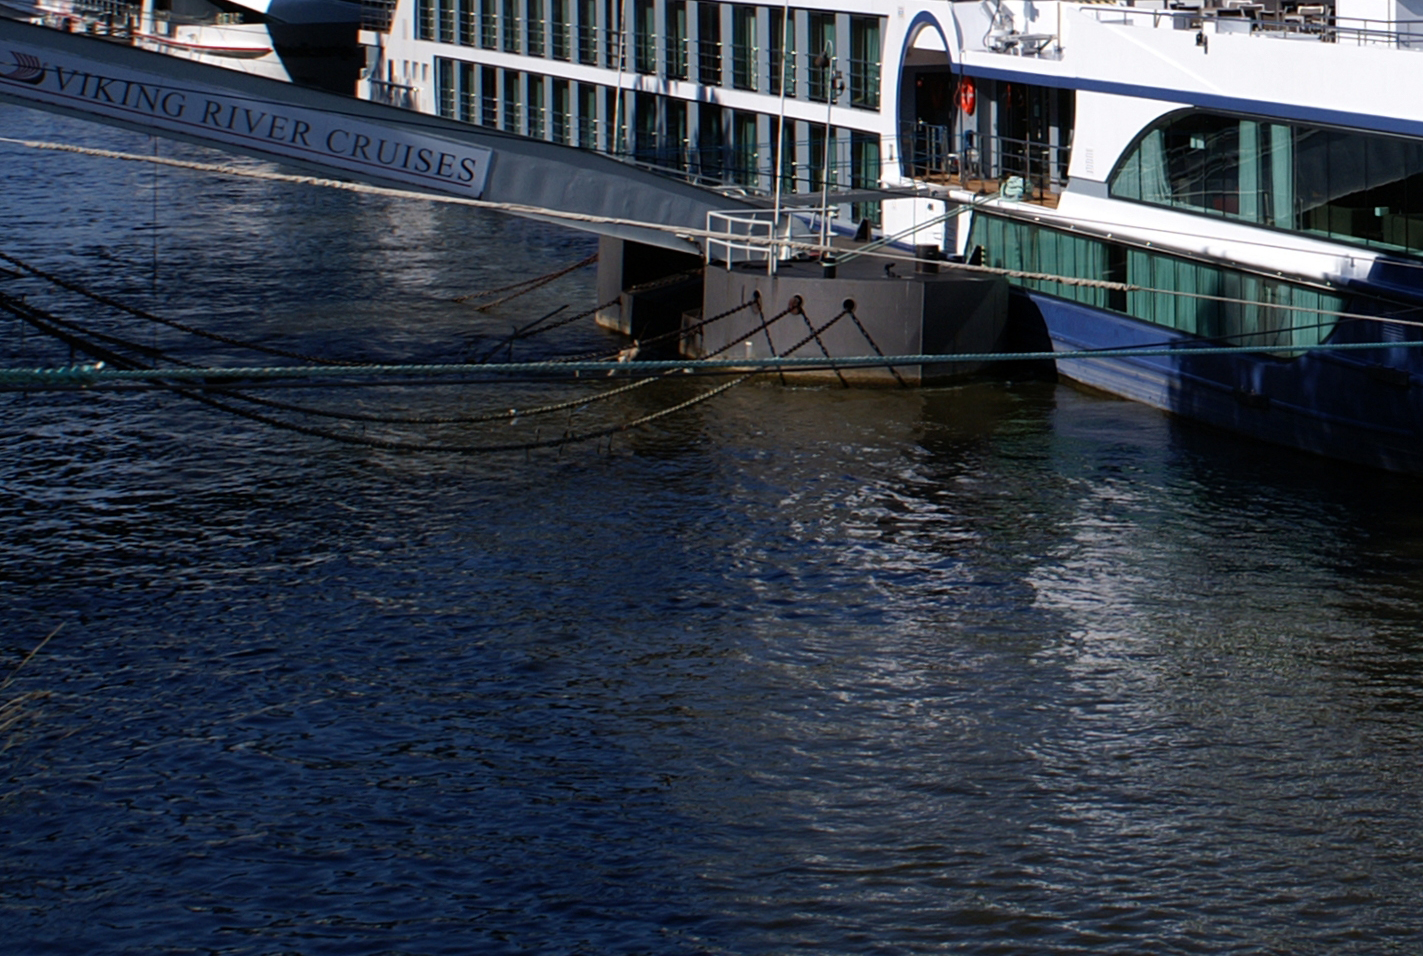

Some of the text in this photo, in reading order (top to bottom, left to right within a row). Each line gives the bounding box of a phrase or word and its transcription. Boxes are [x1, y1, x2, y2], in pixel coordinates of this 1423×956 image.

[53, 65, 477, 183] VIKING RIVER CRUISES
